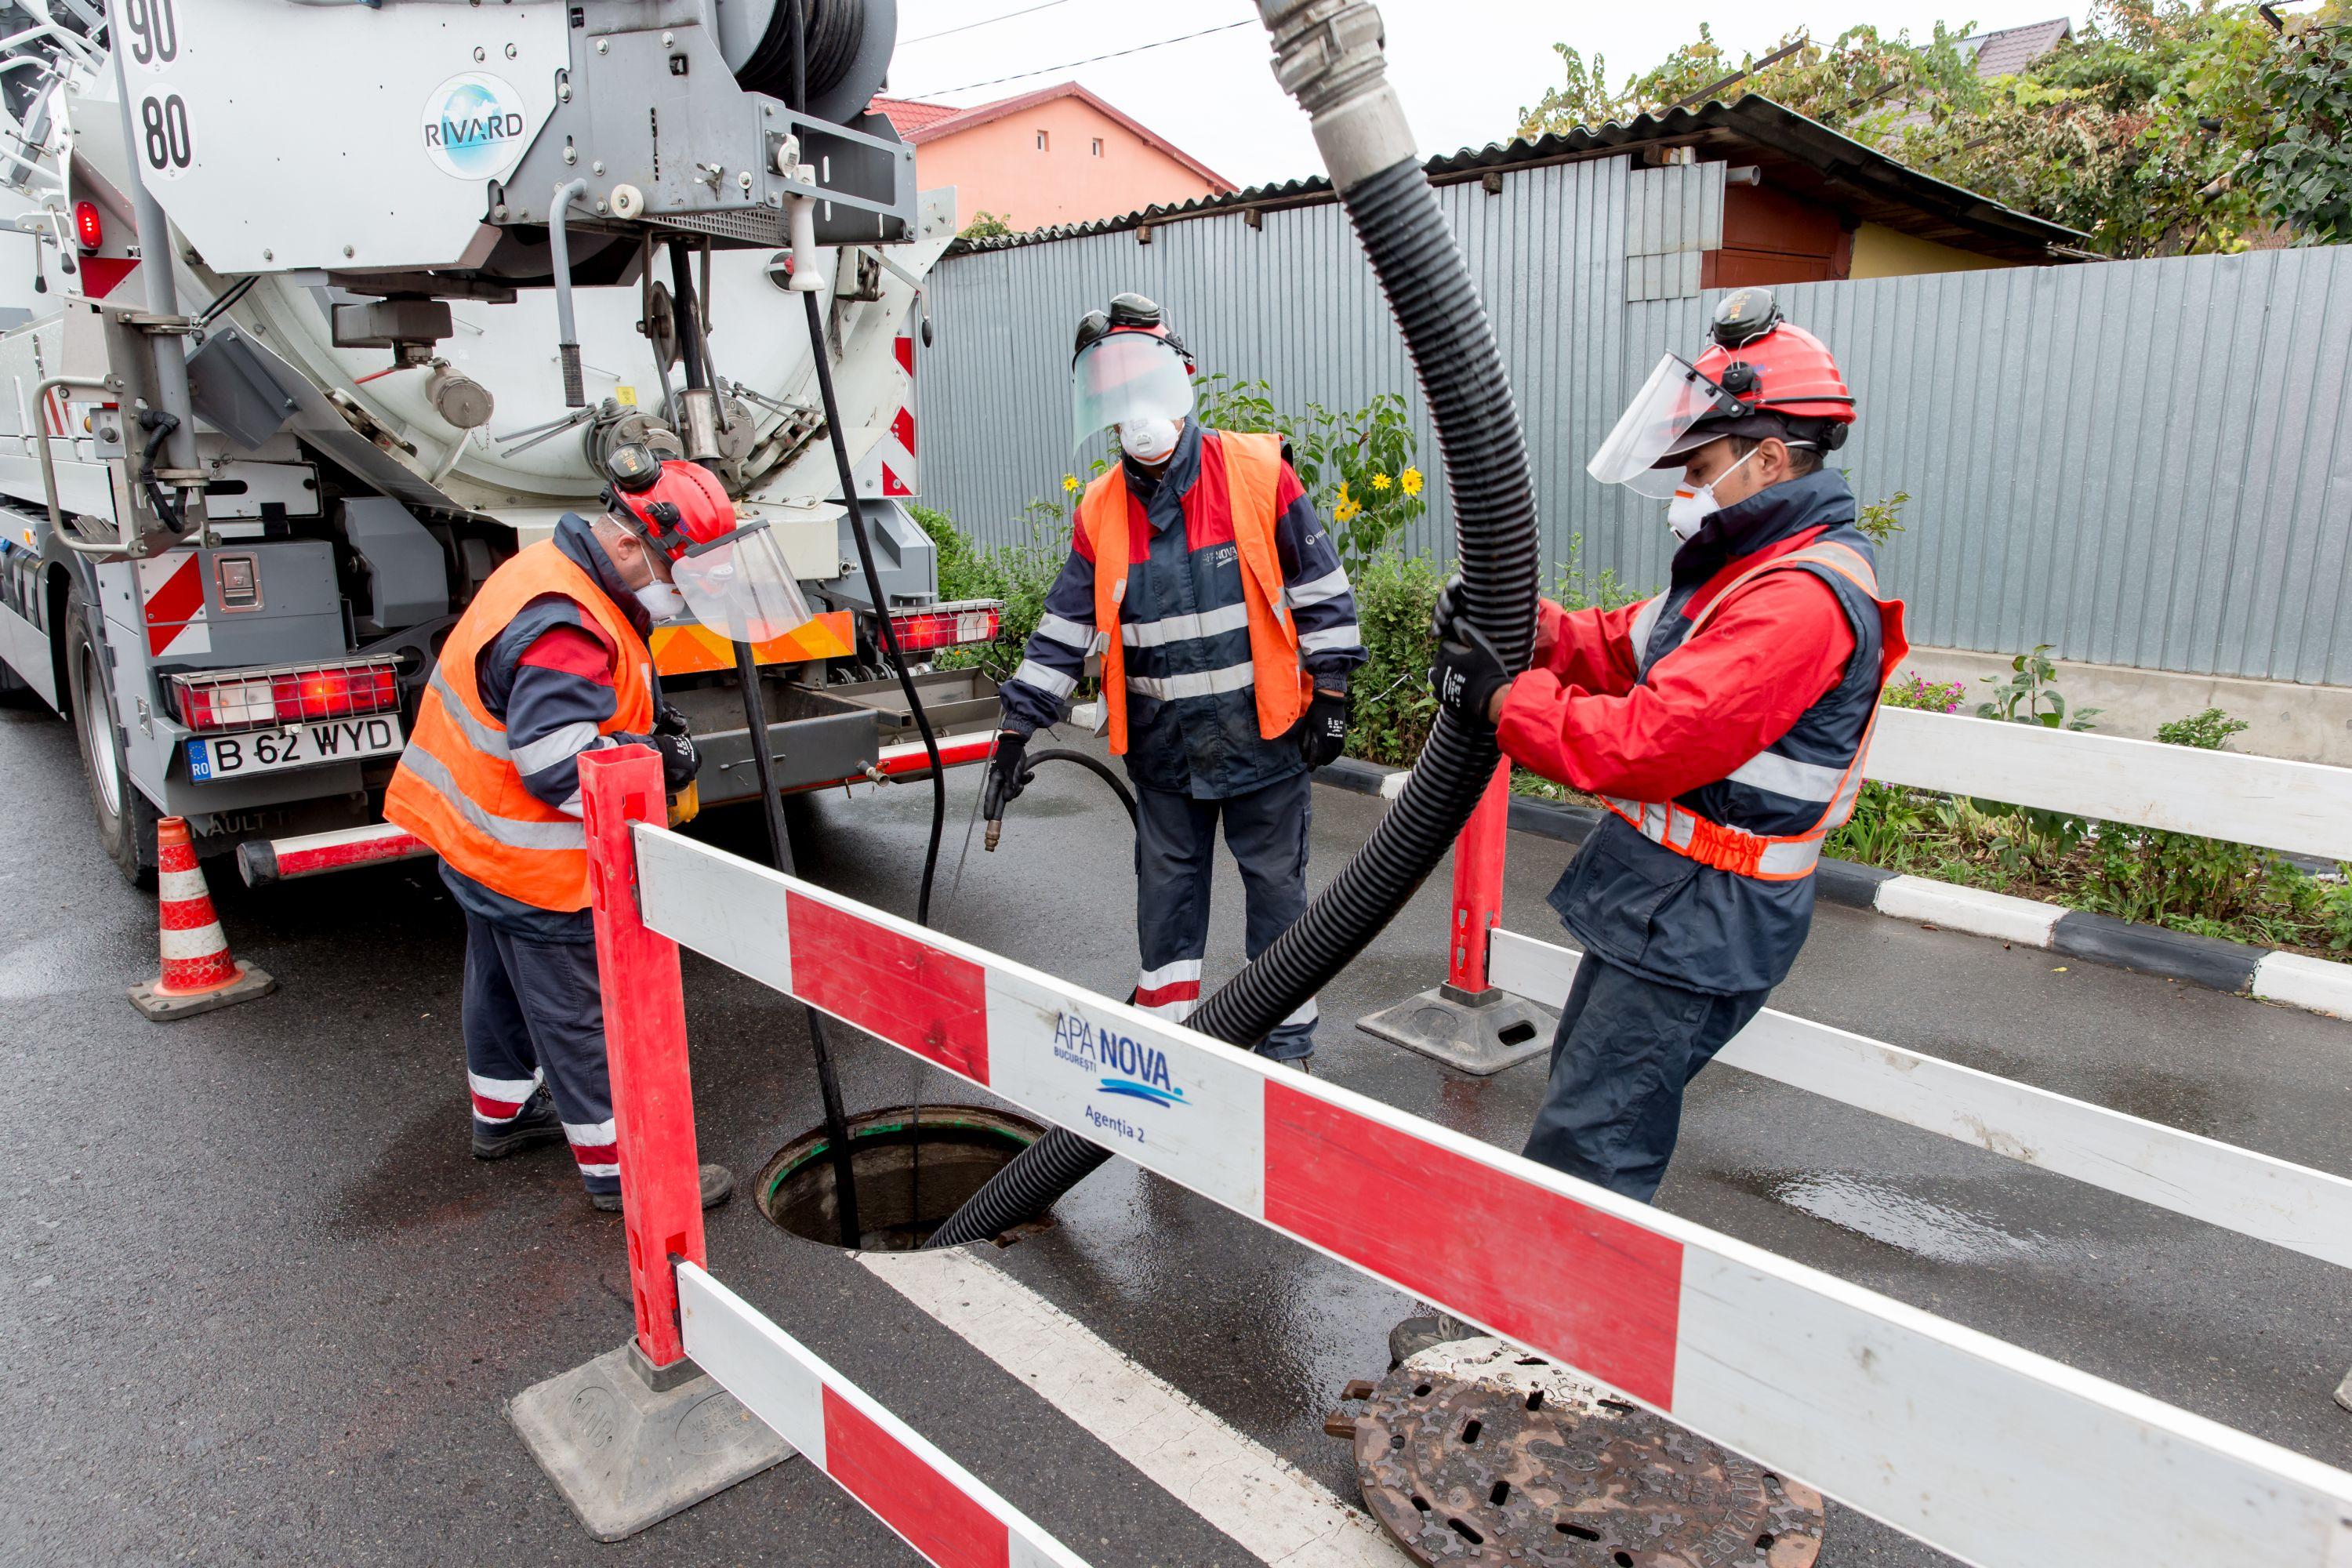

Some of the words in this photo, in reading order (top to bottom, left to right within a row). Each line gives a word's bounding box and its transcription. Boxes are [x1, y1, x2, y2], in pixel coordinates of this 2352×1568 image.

[125, 0, 177, 65] 90
[142, 93, 191, 170] 80
[424, 113, 523, 147] RIVARD
[214, 739, 243, 772] B
[255, 733, 301, 764] 62
[311, 719, 392, 757] WYD
[191, 761, 210, 776] RO
[1054, 1011, 1096, 1060] APA
[1100, 1028, 1171, 1092] NOVA
[1138, 1127, 1145, 1144] 2
[688, 1403, 743, 1432] WATCHMA
[703, 1395, 726, 1412] THE
